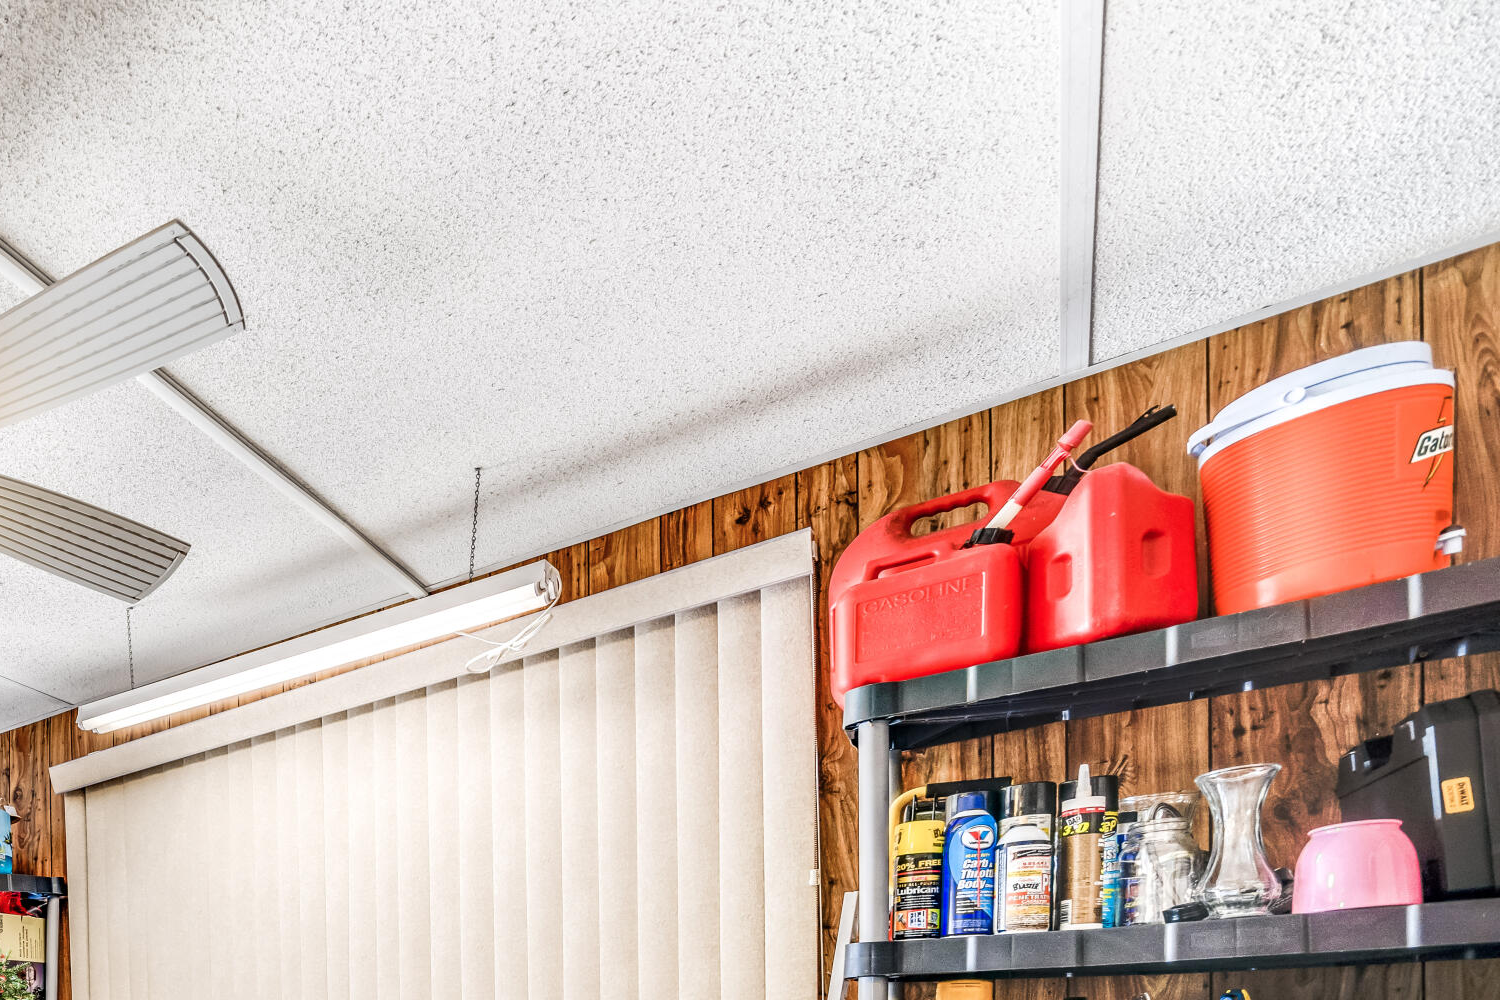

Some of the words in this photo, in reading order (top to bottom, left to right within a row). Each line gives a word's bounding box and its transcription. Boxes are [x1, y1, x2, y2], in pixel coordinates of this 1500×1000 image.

[862, 577, 973, 616] GASOLINE
[918, 859, 942, 868] FREE
[896, 886, 939, 896] Lubricant
